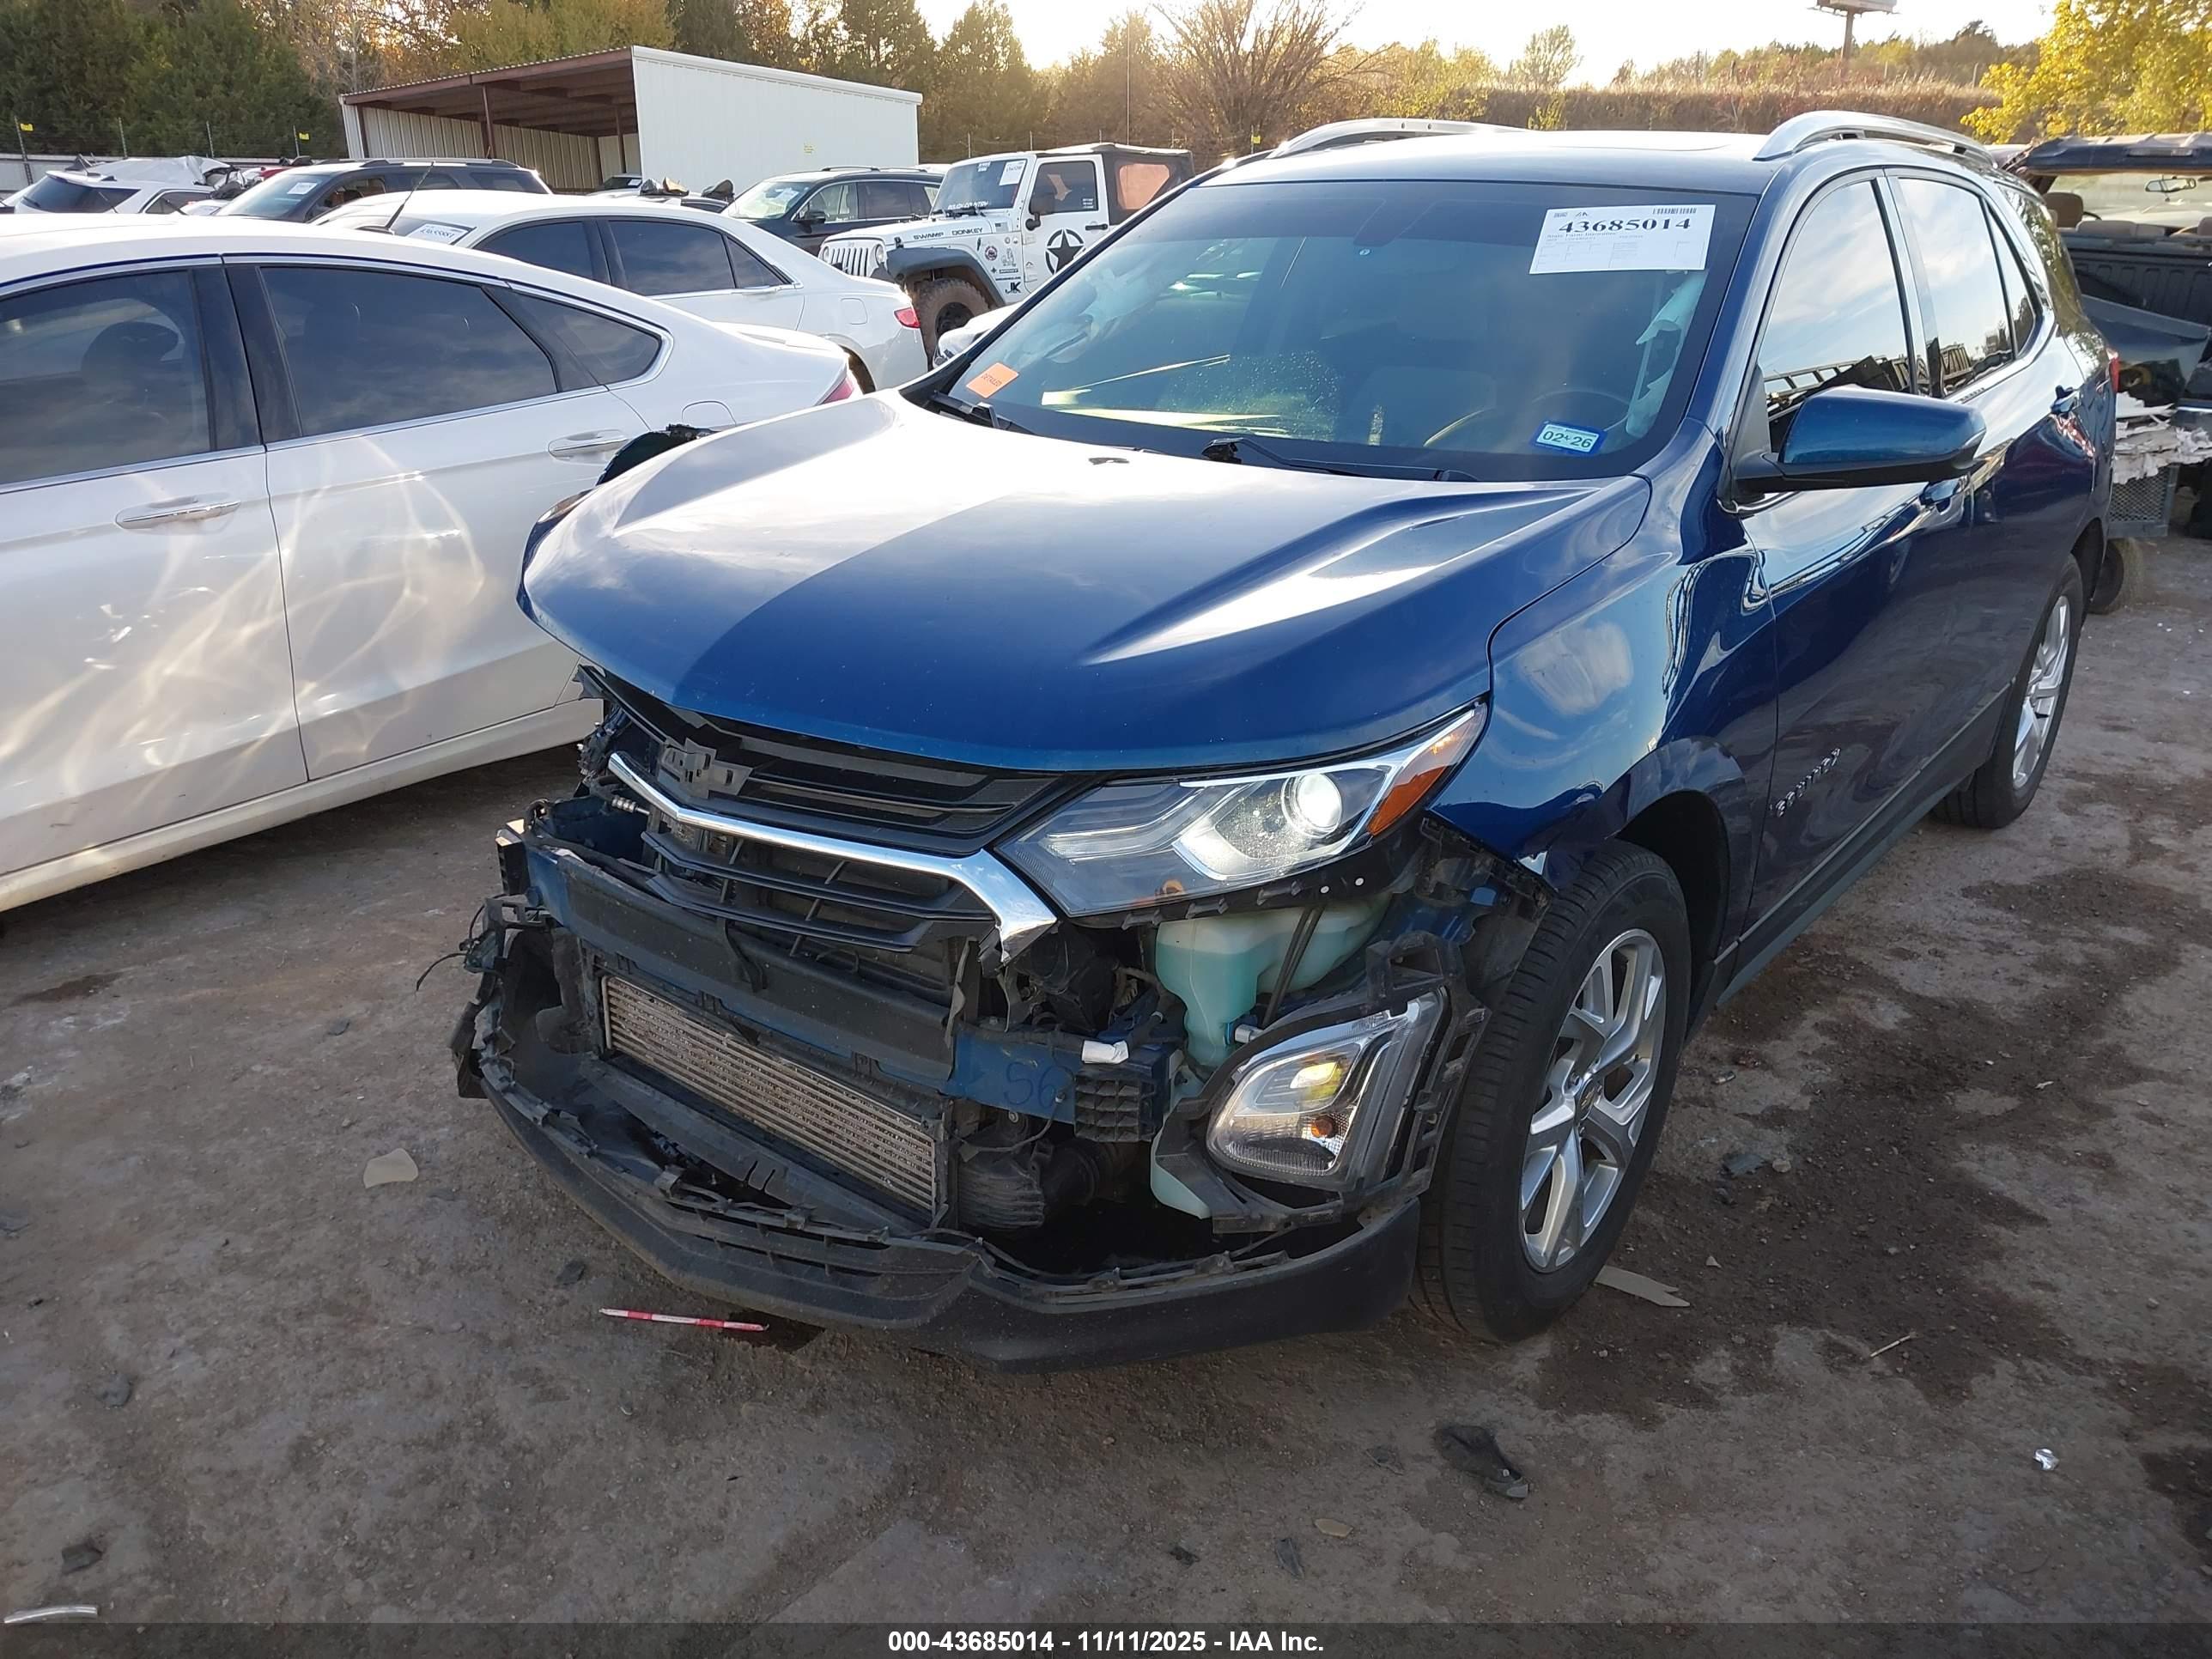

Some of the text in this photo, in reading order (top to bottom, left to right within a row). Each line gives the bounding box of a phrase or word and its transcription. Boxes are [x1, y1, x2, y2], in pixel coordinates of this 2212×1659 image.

[1559, 218, 1691, 233] 43685014
[951, 228, 983, 236] DONKEY
[1005, 282, 1021, 294] JK
[1570, 435, 1593, 448] 26
